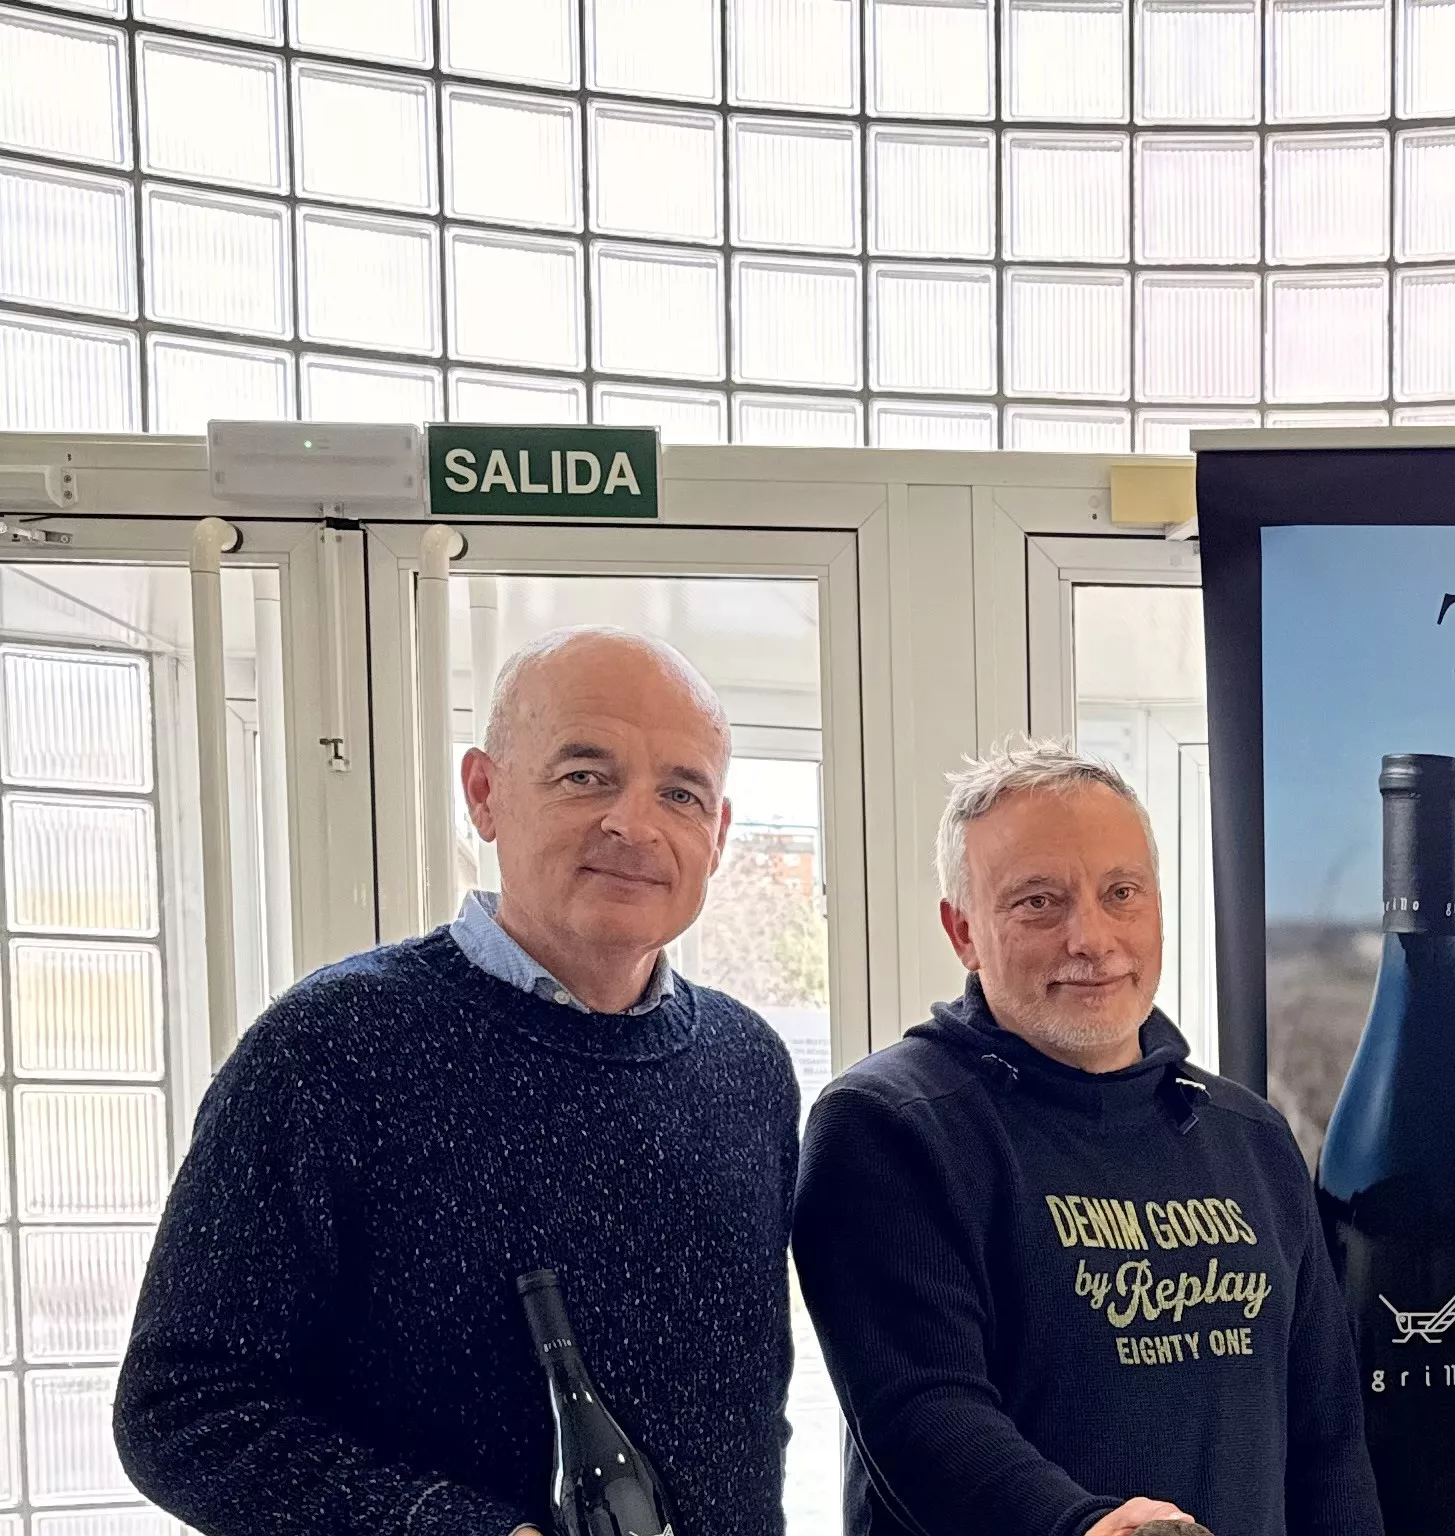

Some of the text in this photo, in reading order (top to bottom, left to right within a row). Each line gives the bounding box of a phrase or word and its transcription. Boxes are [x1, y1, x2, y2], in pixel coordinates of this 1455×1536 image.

[445, 448, 641, 495] SALIDA
[1045, 1194, 1258, 1251] DENIM GOODS
[1074, 1257, 1273, 1329] by Replay
[1115, 1327, 1254, 1366] EIGHTY ONE
